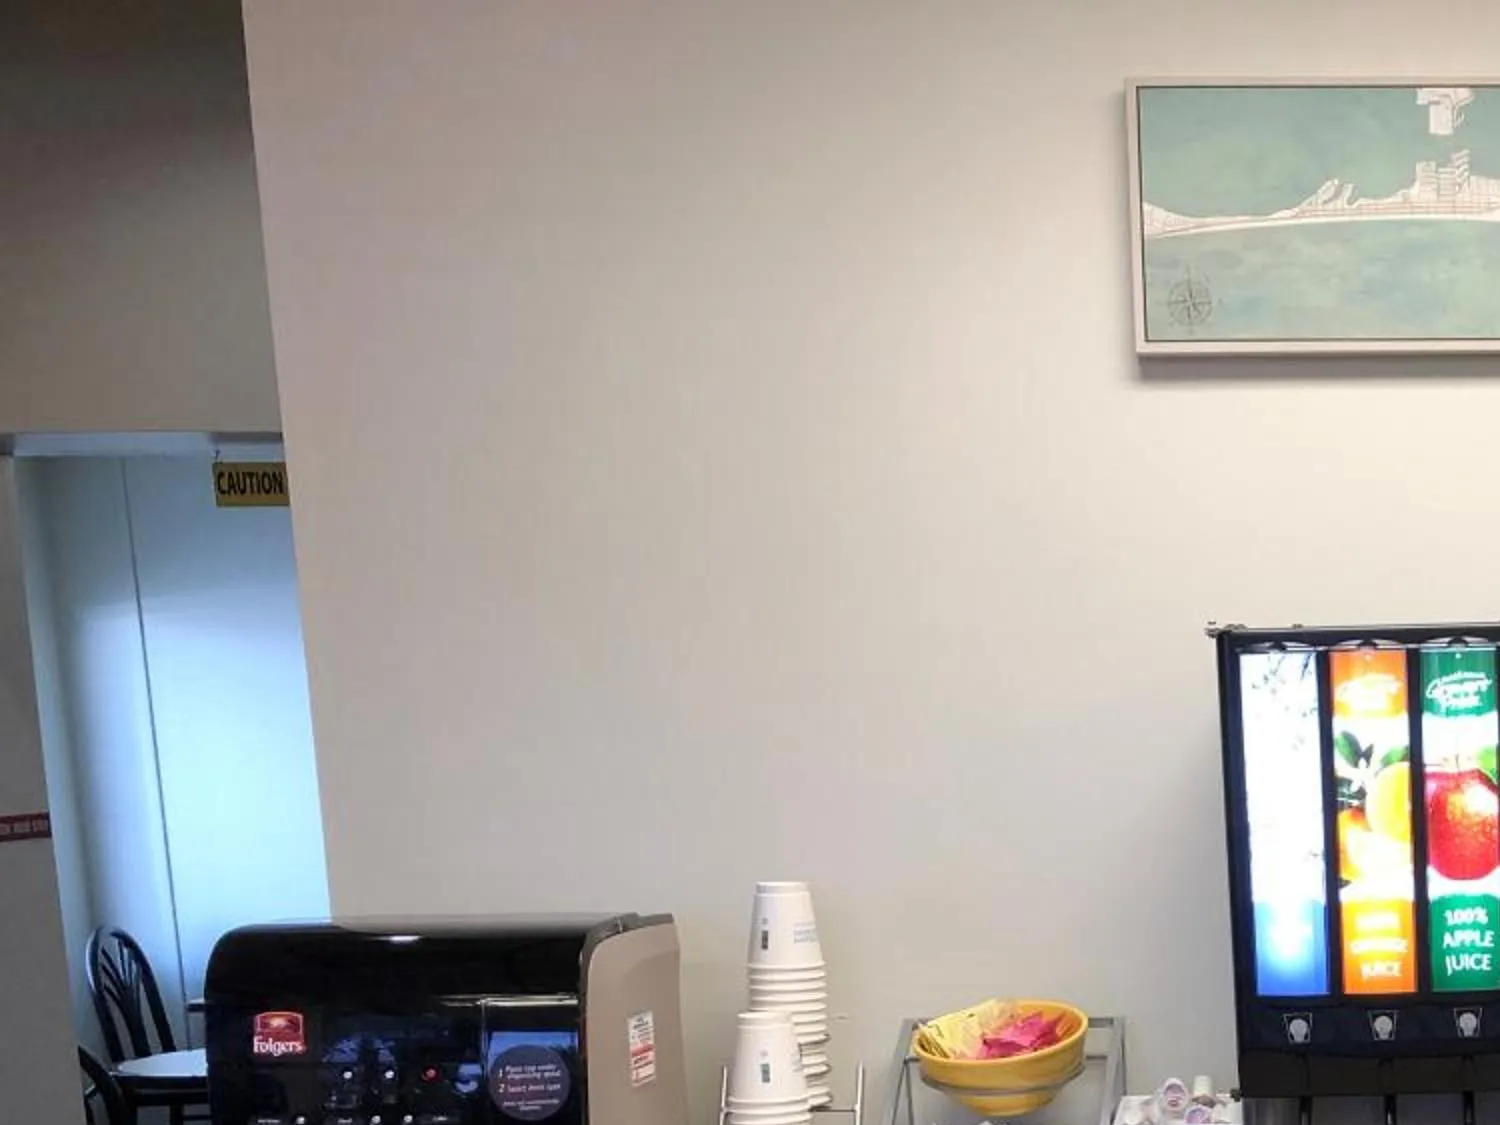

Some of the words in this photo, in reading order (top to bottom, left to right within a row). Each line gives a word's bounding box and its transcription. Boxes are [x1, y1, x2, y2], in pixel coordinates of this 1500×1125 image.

[217, 471, 284, 495] CAUTION
[1444, 906, 1489, 926] 100%
[1443, 929, 1495, 949] APPLE
[1445, 953, 1492, 976] JUICE
